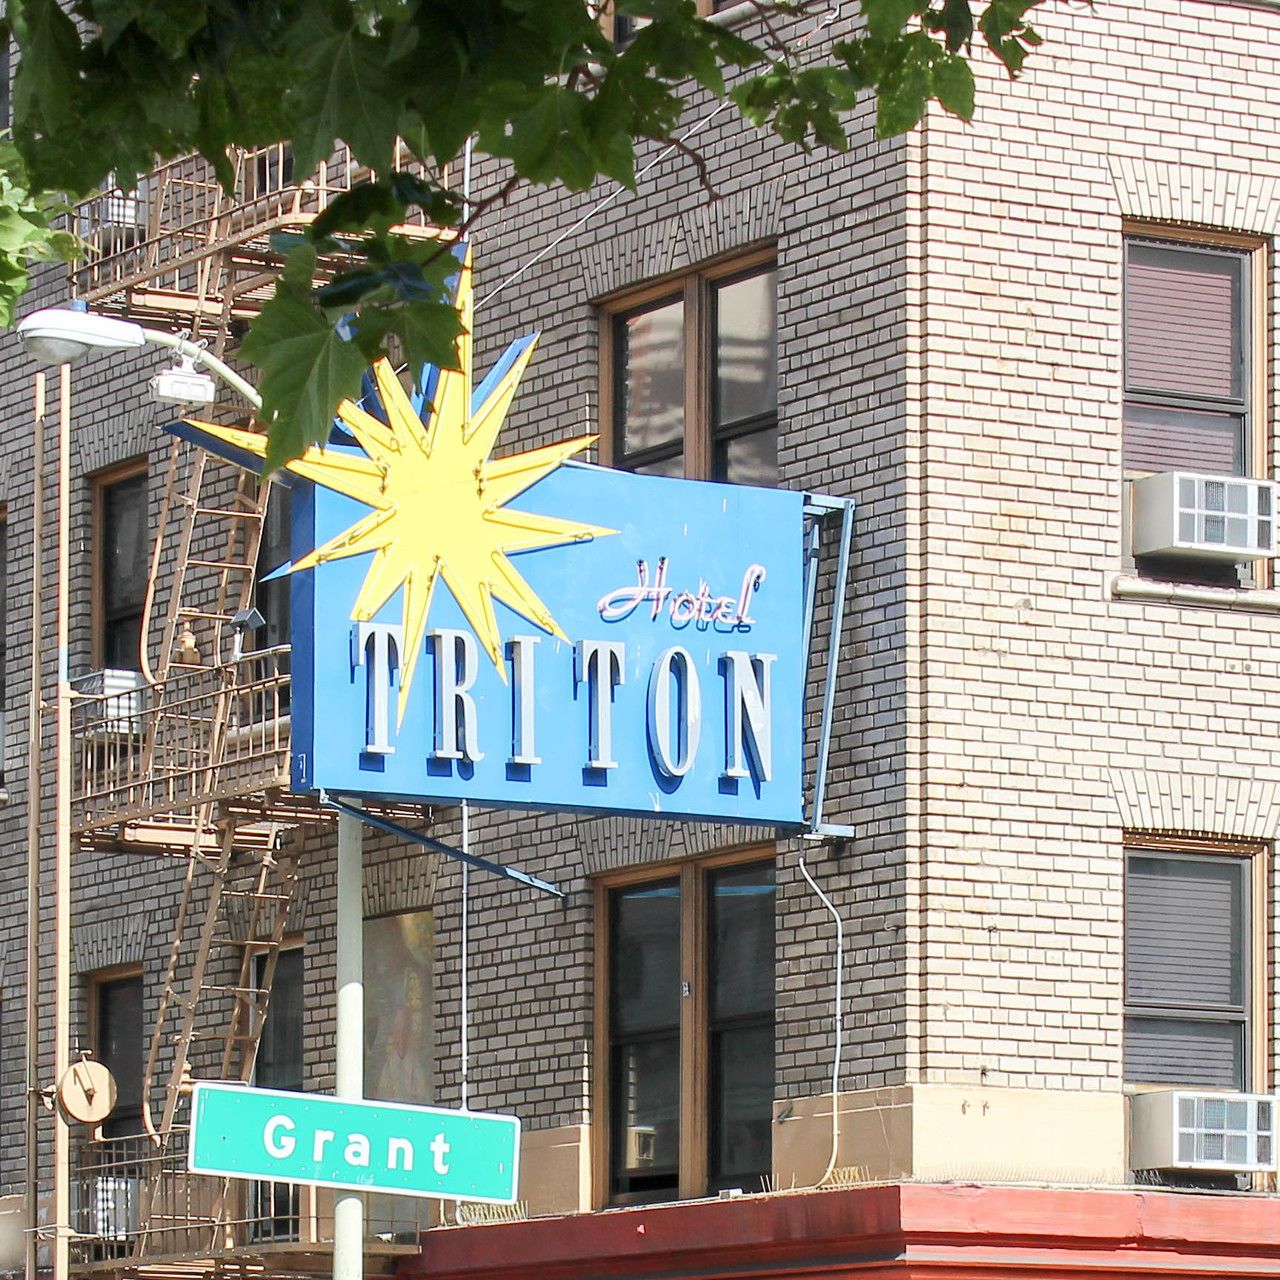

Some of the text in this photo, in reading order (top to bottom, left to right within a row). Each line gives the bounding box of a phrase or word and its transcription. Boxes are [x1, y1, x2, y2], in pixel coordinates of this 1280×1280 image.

[597, 556, 766, 625] Hotel
[351, 620, 778, 782] TRITON
[262, 1114, 451, 1176] Grant
